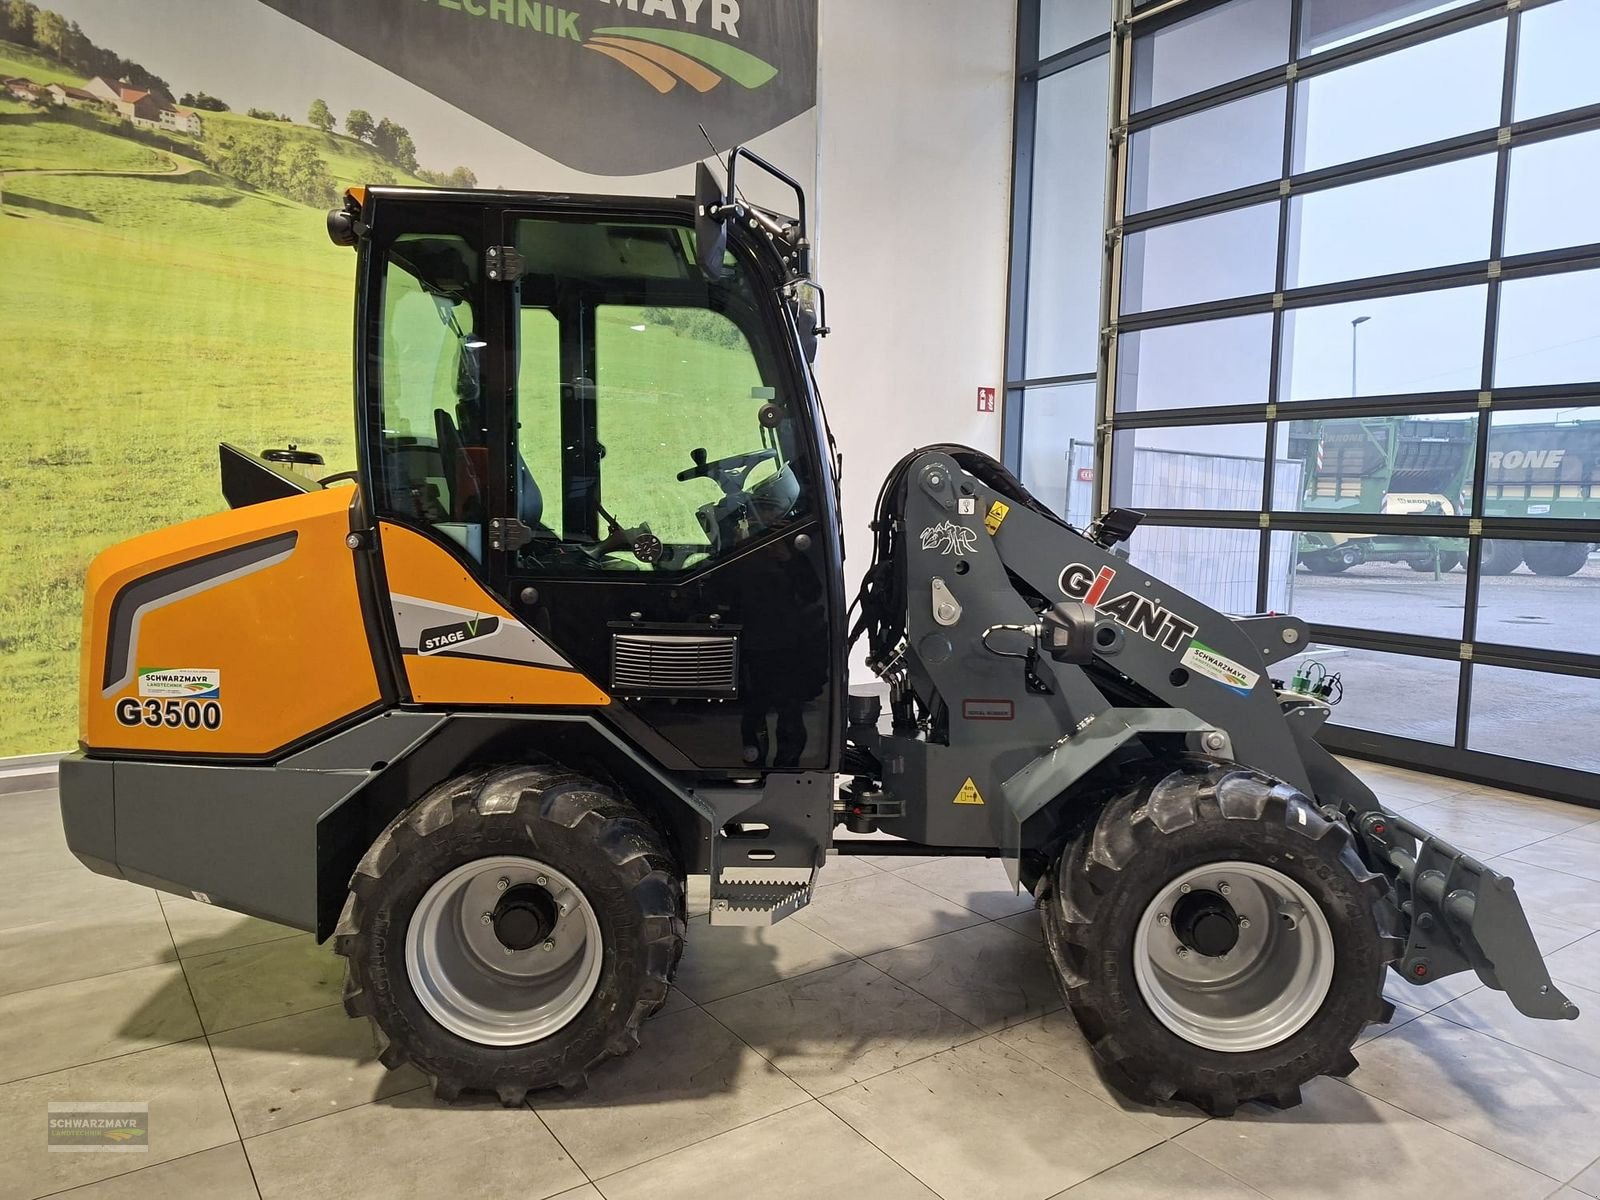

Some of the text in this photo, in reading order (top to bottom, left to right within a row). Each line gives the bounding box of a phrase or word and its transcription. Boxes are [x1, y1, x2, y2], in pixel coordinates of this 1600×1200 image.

[425, 630, 465, 649] STAGE
[1194, 649, 1247, 680] SCHWARZMAYR
[145, 674, 208, 682] SCHWARZMAYR
[116, 698, 221, 730] G3500
